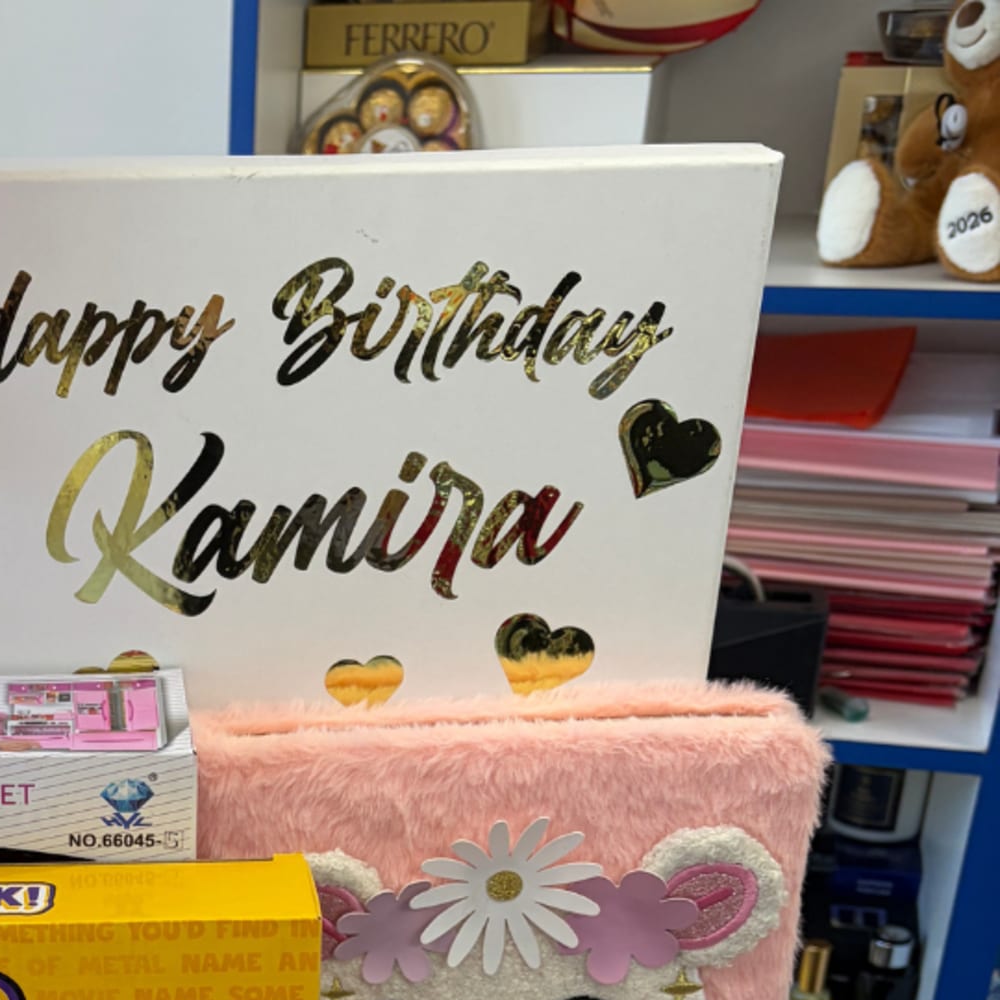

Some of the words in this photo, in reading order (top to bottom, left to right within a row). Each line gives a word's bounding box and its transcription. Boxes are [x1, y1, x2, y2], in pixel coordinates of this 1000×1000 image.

[344, 20, 489, 57] FERRERO
[947, 205, 994, 239] 2026
[272, 257, 673, 400] Birthday
[45, 430, 584, 617] Kamira
[126, 920, 206, 942] YOU'D
[216, 919, 279, 940] FIND
[291, 918, 319, 939] IN
[27, 957, 60, 977] OF
[79, 955, 166, 976] METAL
[181, 953, 262, 973] NAME
[278, 952, 319, 972] AN
